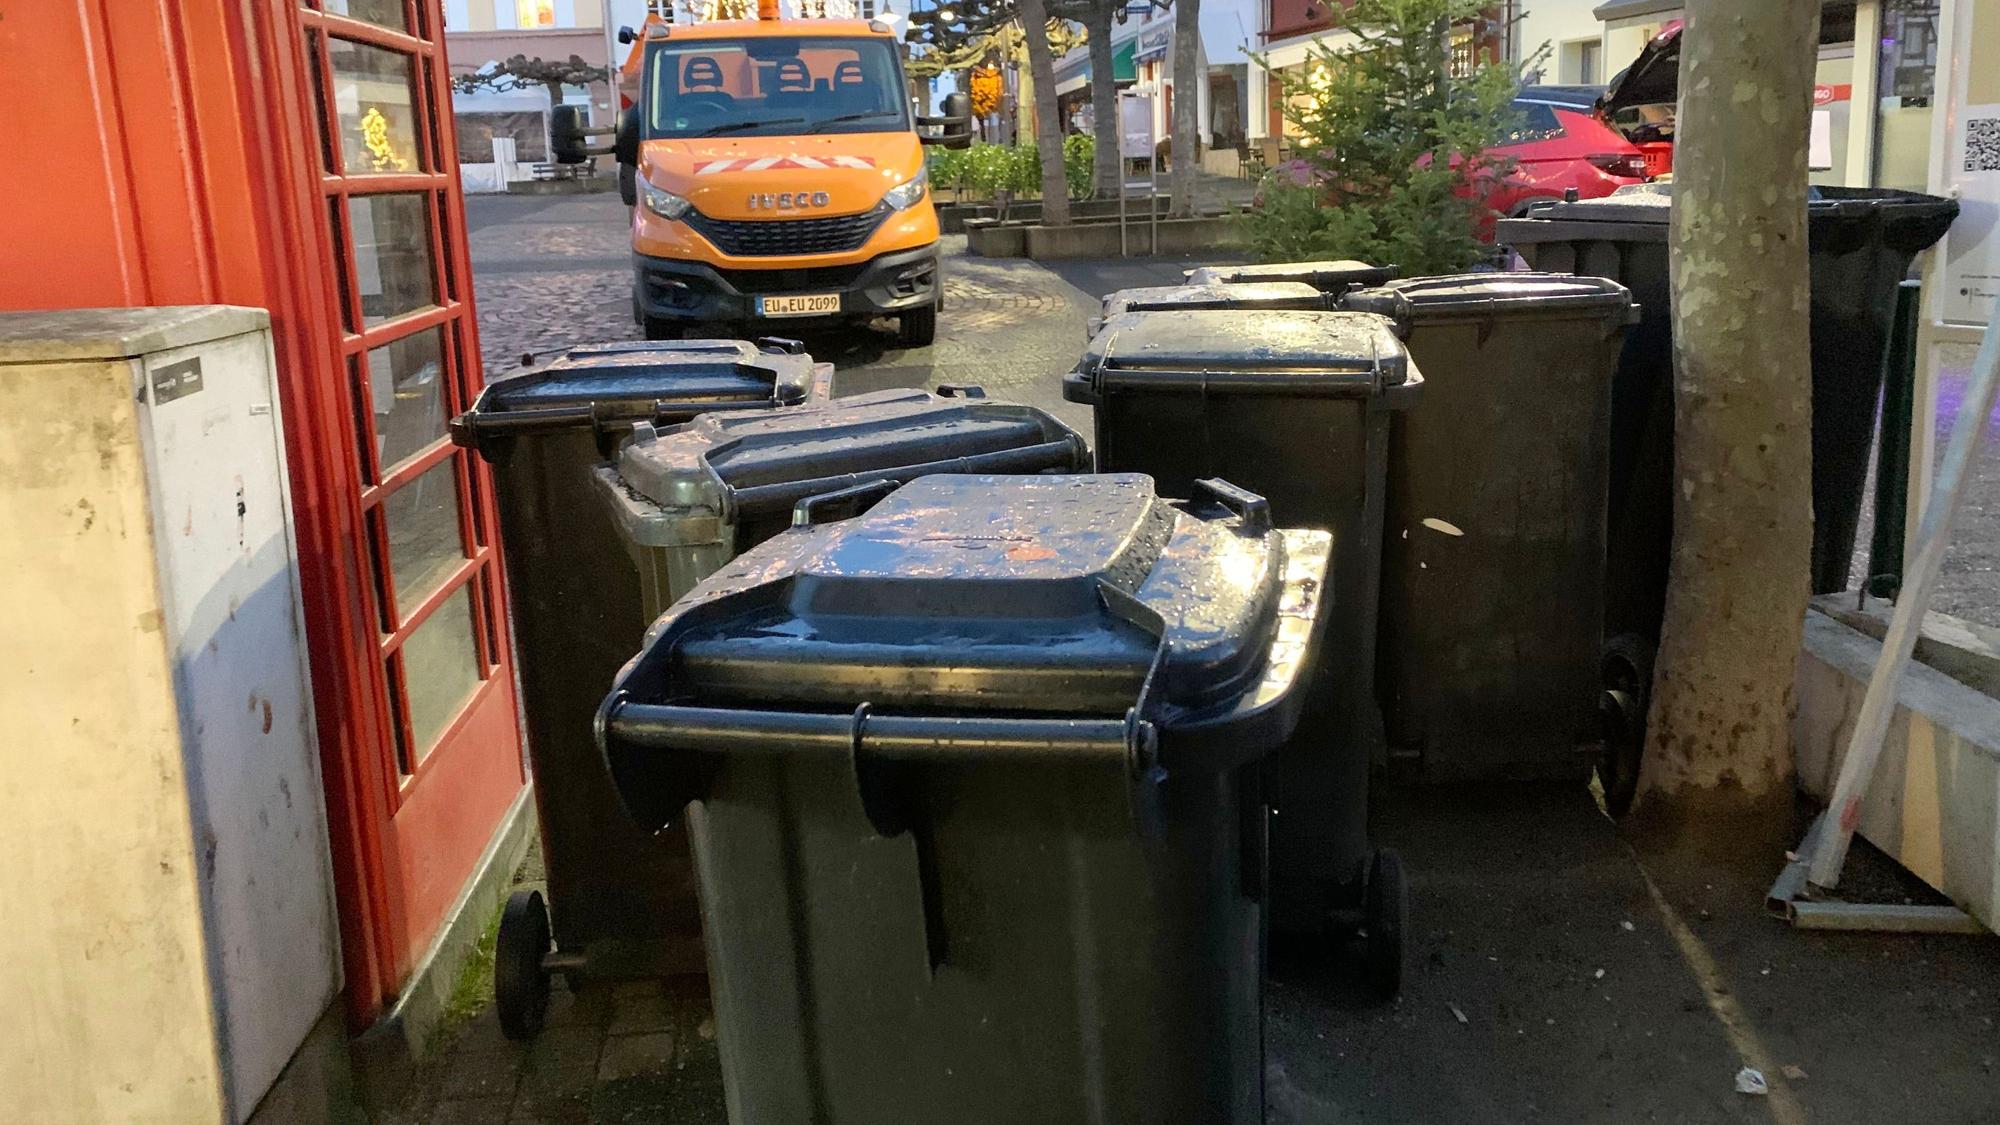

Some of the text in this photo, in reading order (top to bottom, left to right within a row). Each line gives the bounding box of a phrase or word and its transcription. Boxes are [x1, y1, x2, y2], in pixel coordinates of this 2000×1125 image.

[749, 191, 830, 209] IVECO
[764, 299, 780, 313] EU
[789, 298, 805, 312] EU
[808, 296, 838, 311] 2099
